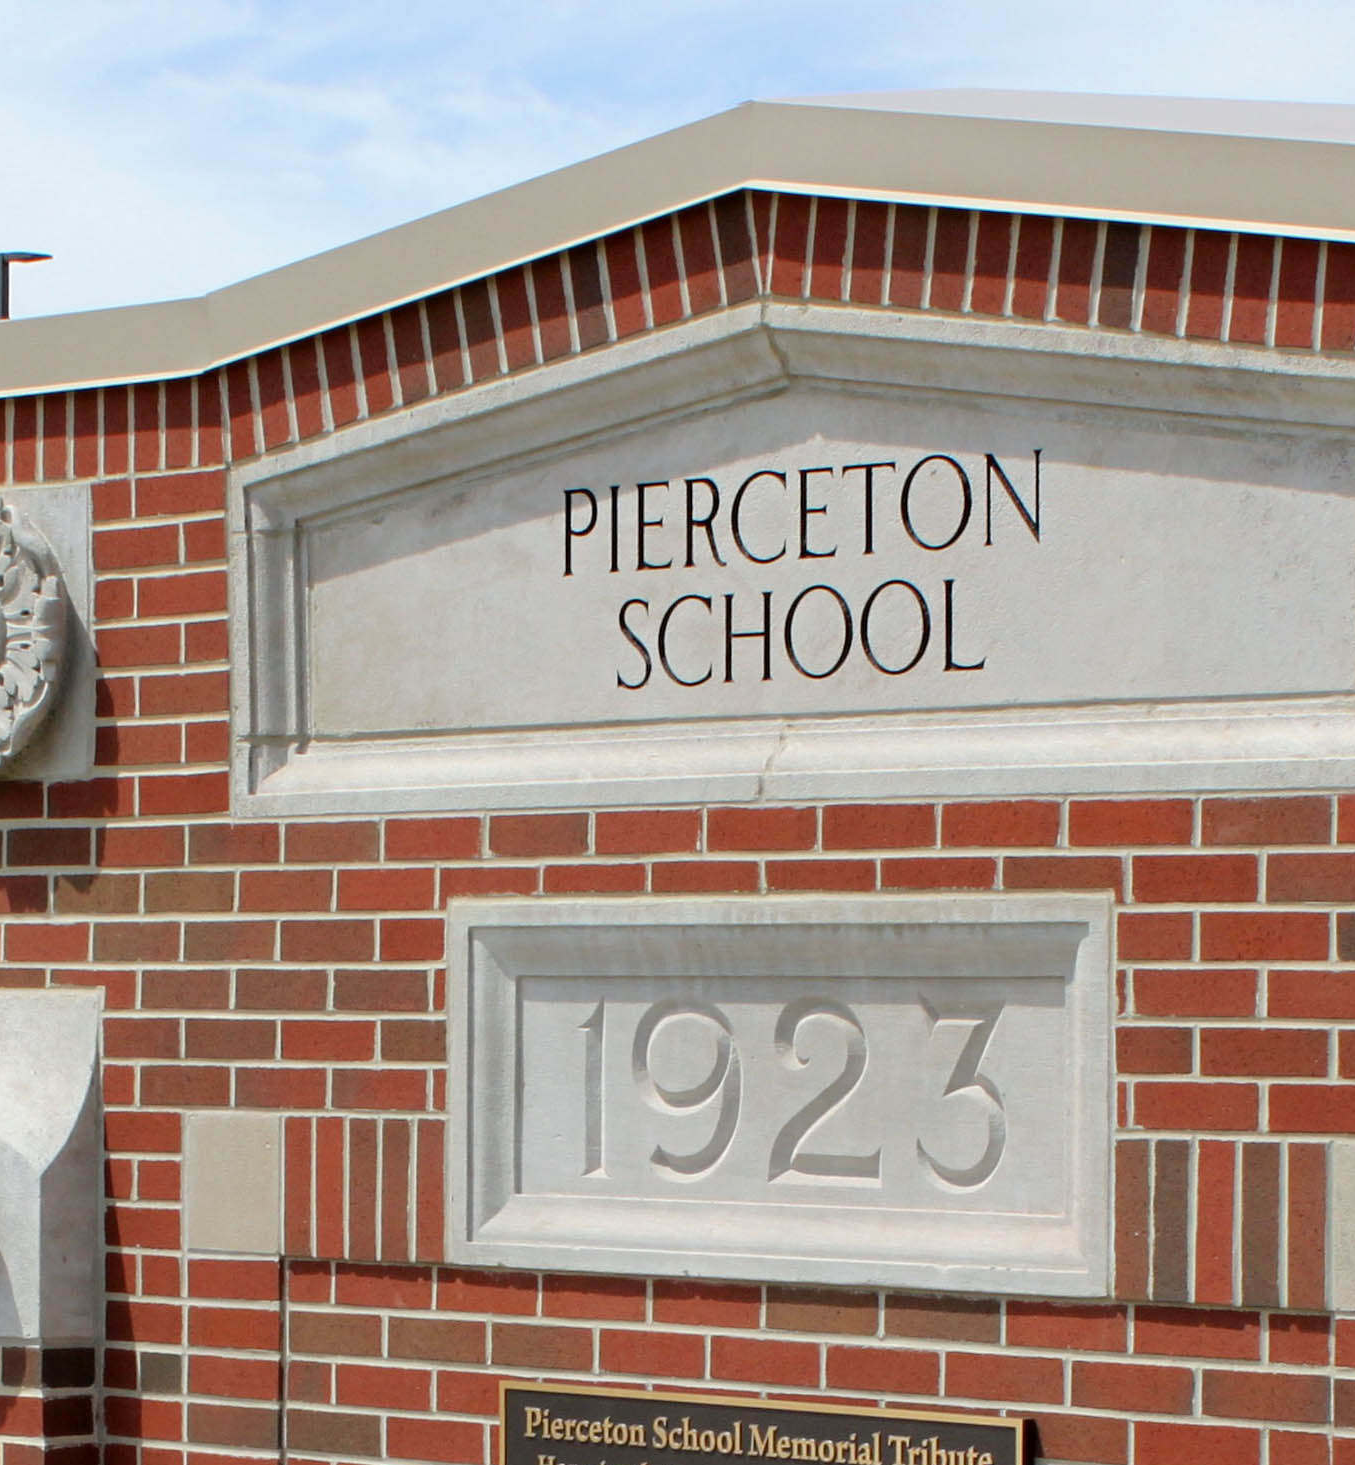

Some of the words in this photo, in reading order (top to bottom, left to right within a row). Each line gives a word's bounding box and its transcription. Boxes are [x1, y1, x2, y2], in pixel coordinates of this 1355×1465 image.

[563, 449, 1043, 577] PIERCETON
[616, 579, 987, 690] SCHOOL
[577, 992, 1007, 1194] 1923
[524, 1405, 645, 1447] Pierceton
[652, 1414, 742, 1455] School
